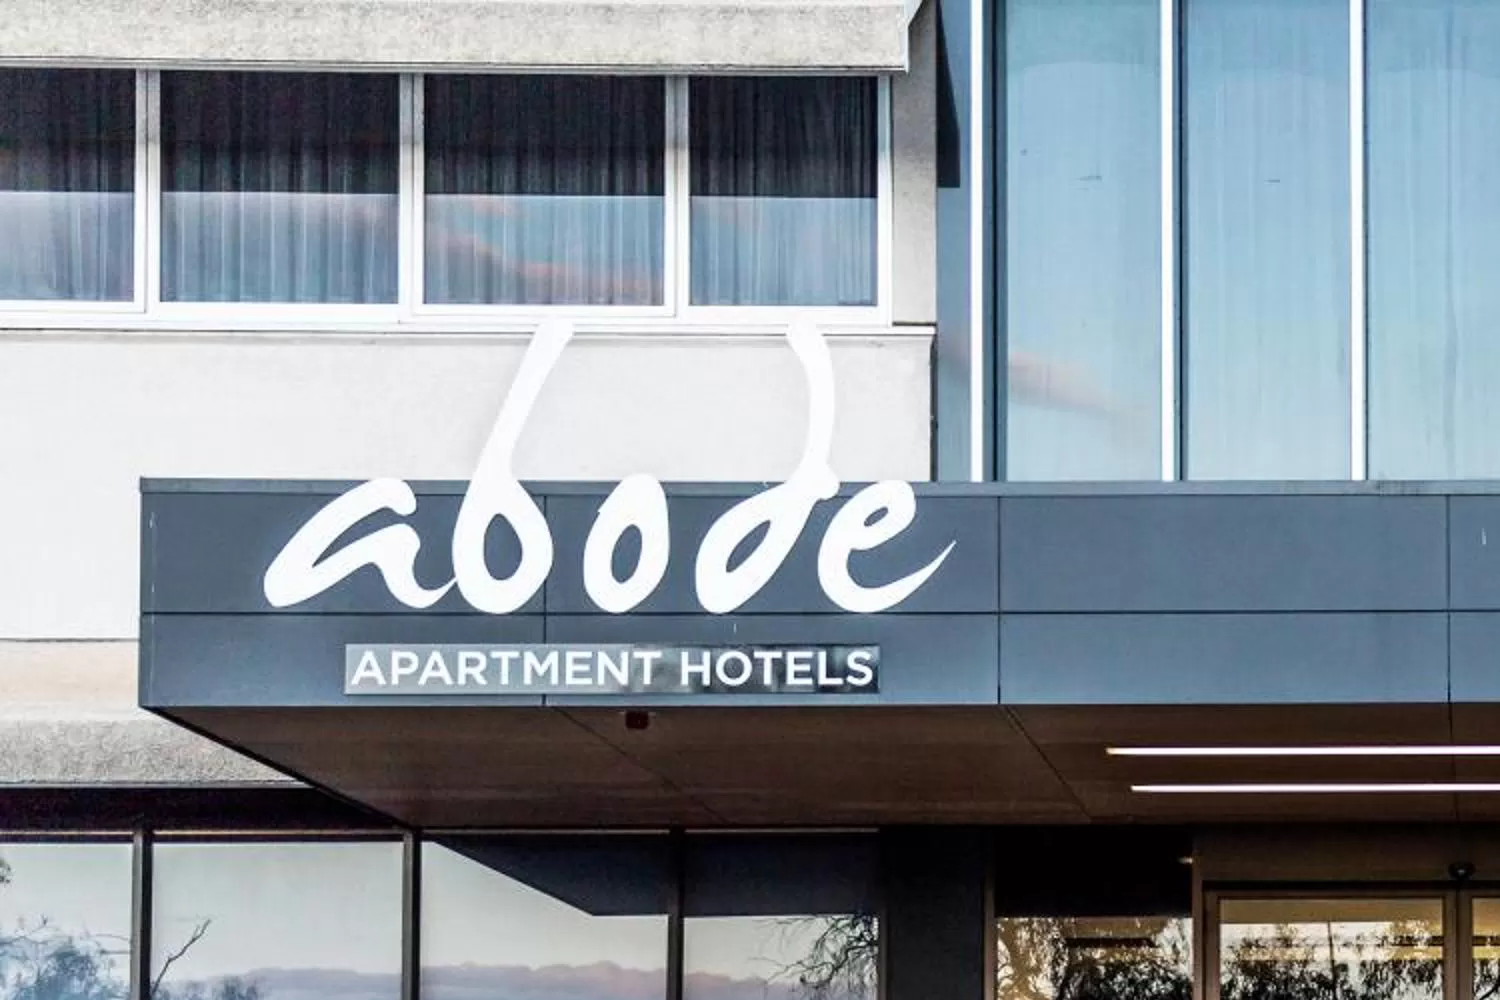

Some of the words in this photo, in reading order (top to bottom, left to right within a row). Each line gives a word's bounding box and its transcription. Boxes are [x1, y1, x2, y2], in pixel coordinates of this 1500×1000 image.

[264, 318, 956, 615] abode
[350, 650, 662, 686] APARTMENT
[679, 649, 874, 687] HOTELS
